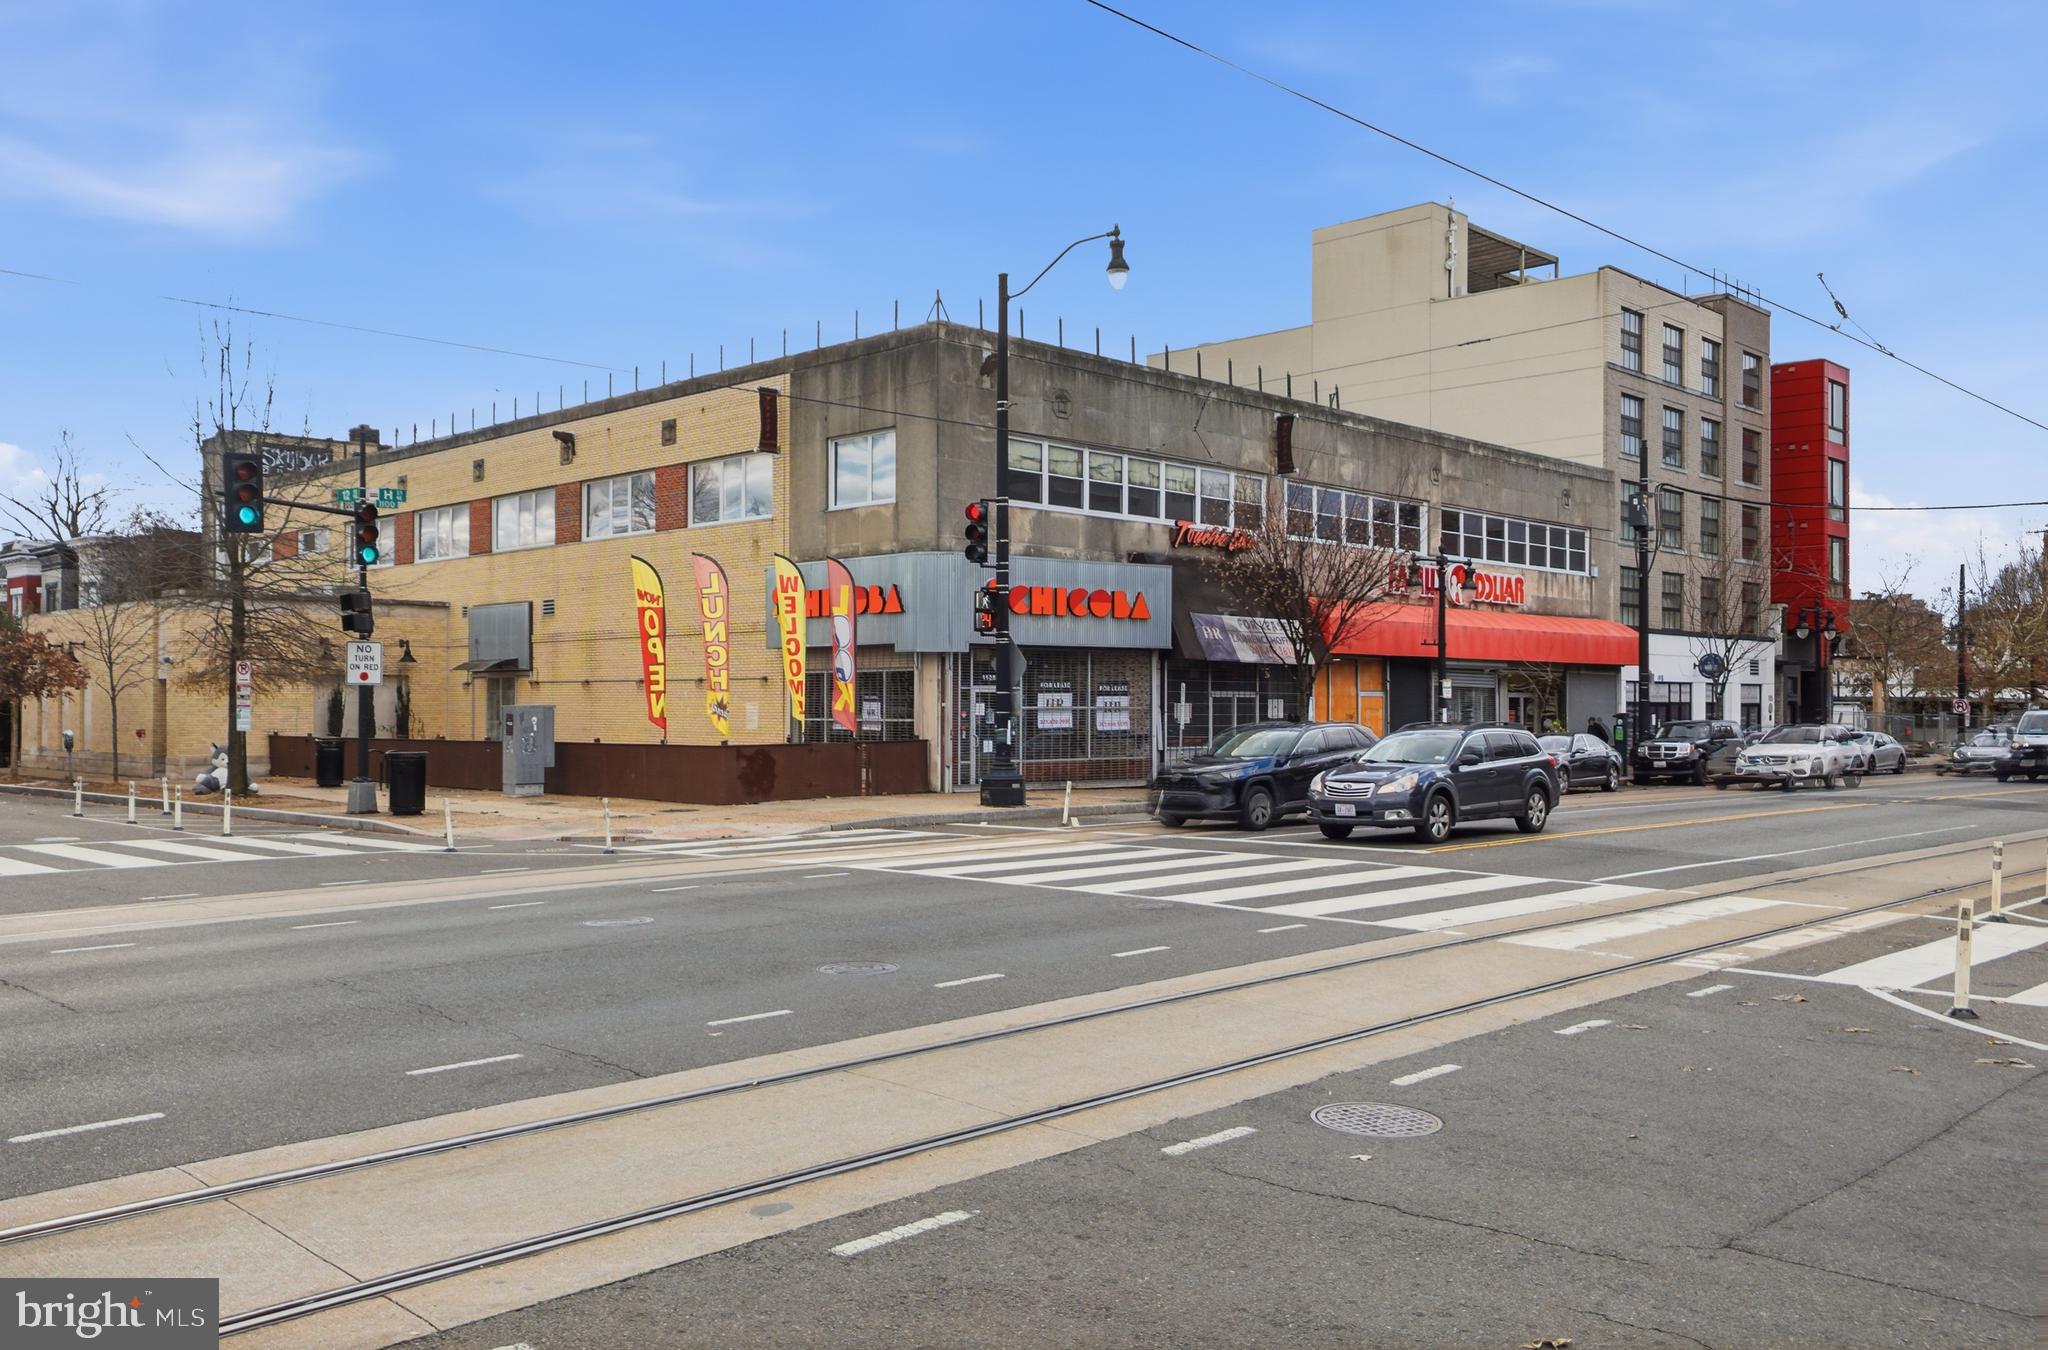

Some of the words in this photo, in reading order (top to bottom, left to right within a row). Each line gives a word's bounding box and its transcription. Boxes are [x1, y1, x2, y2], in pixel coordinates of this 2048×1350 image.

[383, 489, 393, 500] H
[1388, 562, 1441, 596] FAIL
[1474, 572, 1525, 604] DOLLAR
[1008, 585, 1152, 620] CHICOBA
[356, 645, 372, 653] NO
